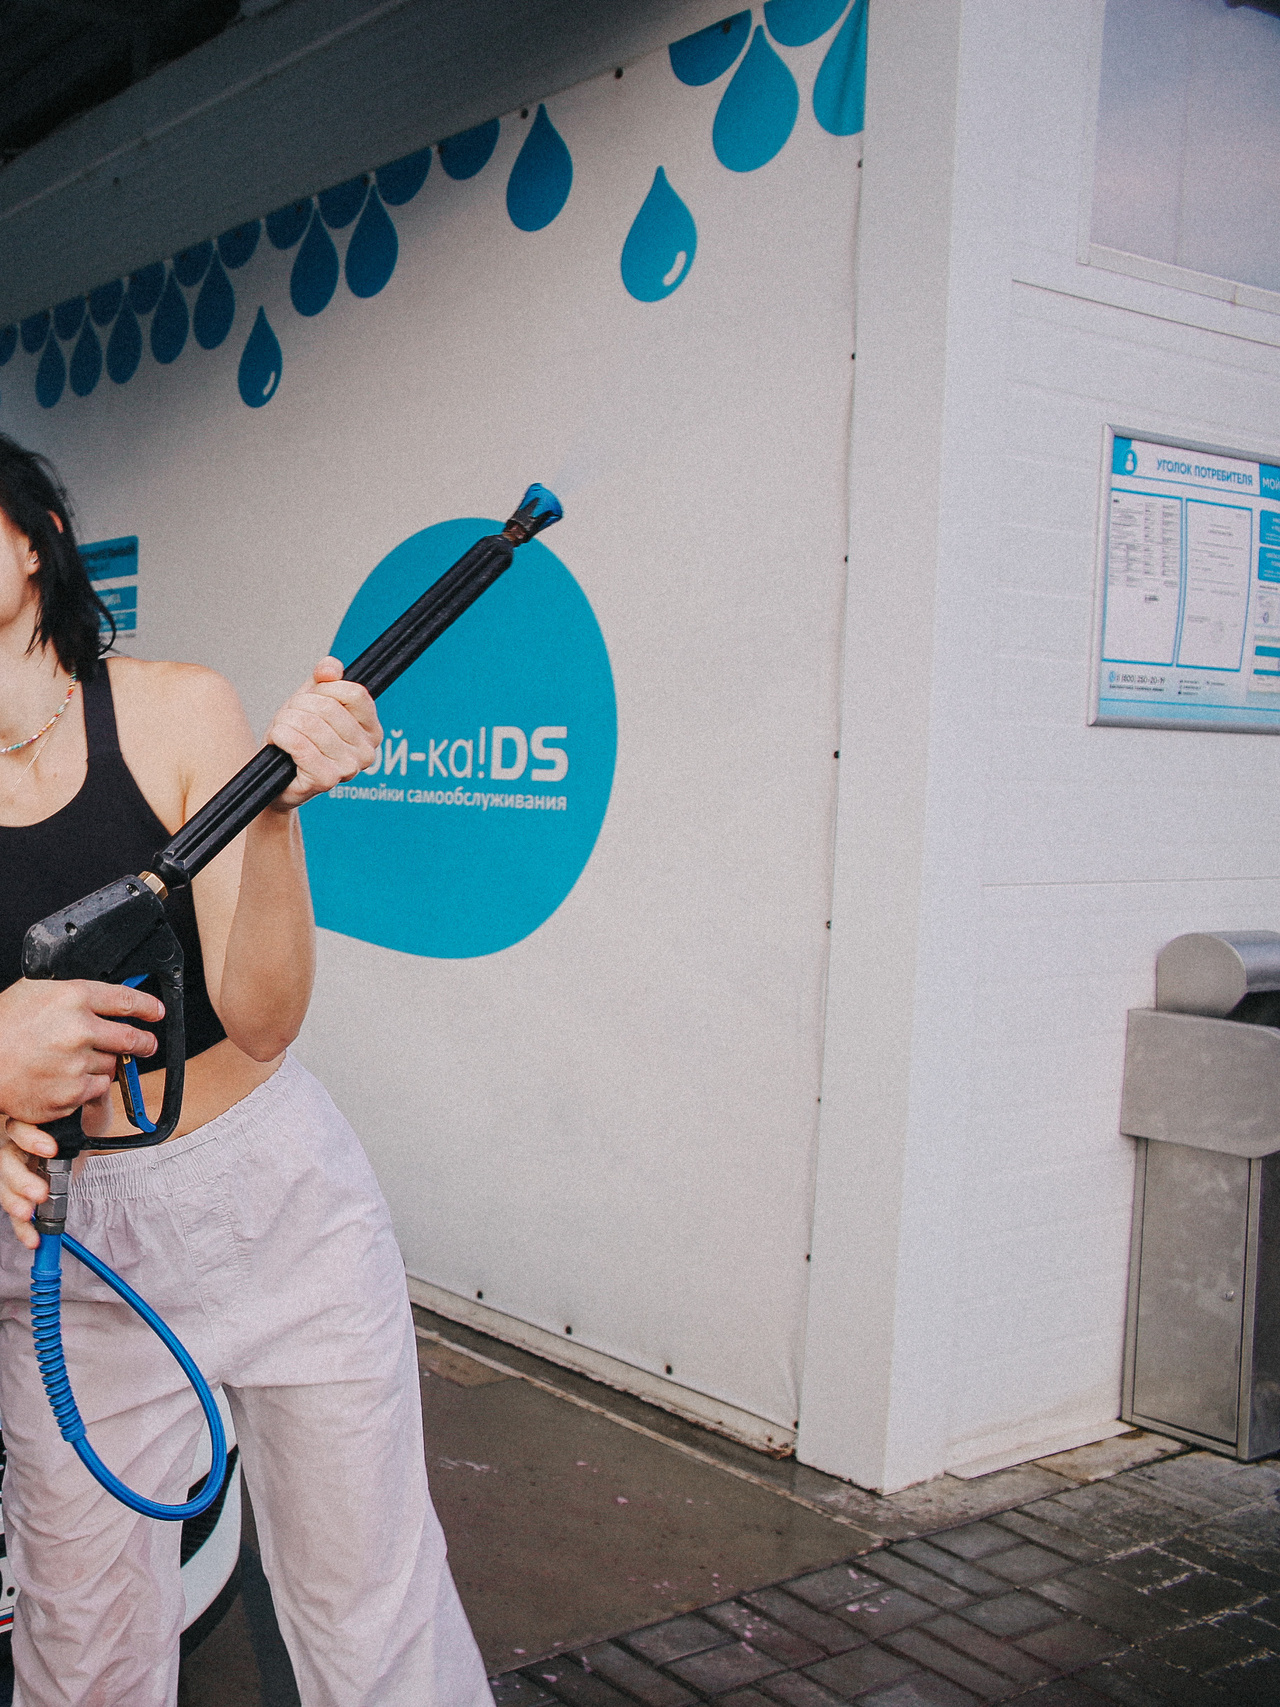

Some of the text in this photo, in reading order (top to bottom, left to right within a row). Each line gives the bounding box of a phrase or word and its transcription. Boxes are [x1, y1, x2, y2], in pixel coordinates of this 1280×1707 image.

[1157, 459, 1253, 486] УГОЛОК ПОТРЕБИТЕЛЯ
[328, 783, 568, 812] автомойки самообслуживания
